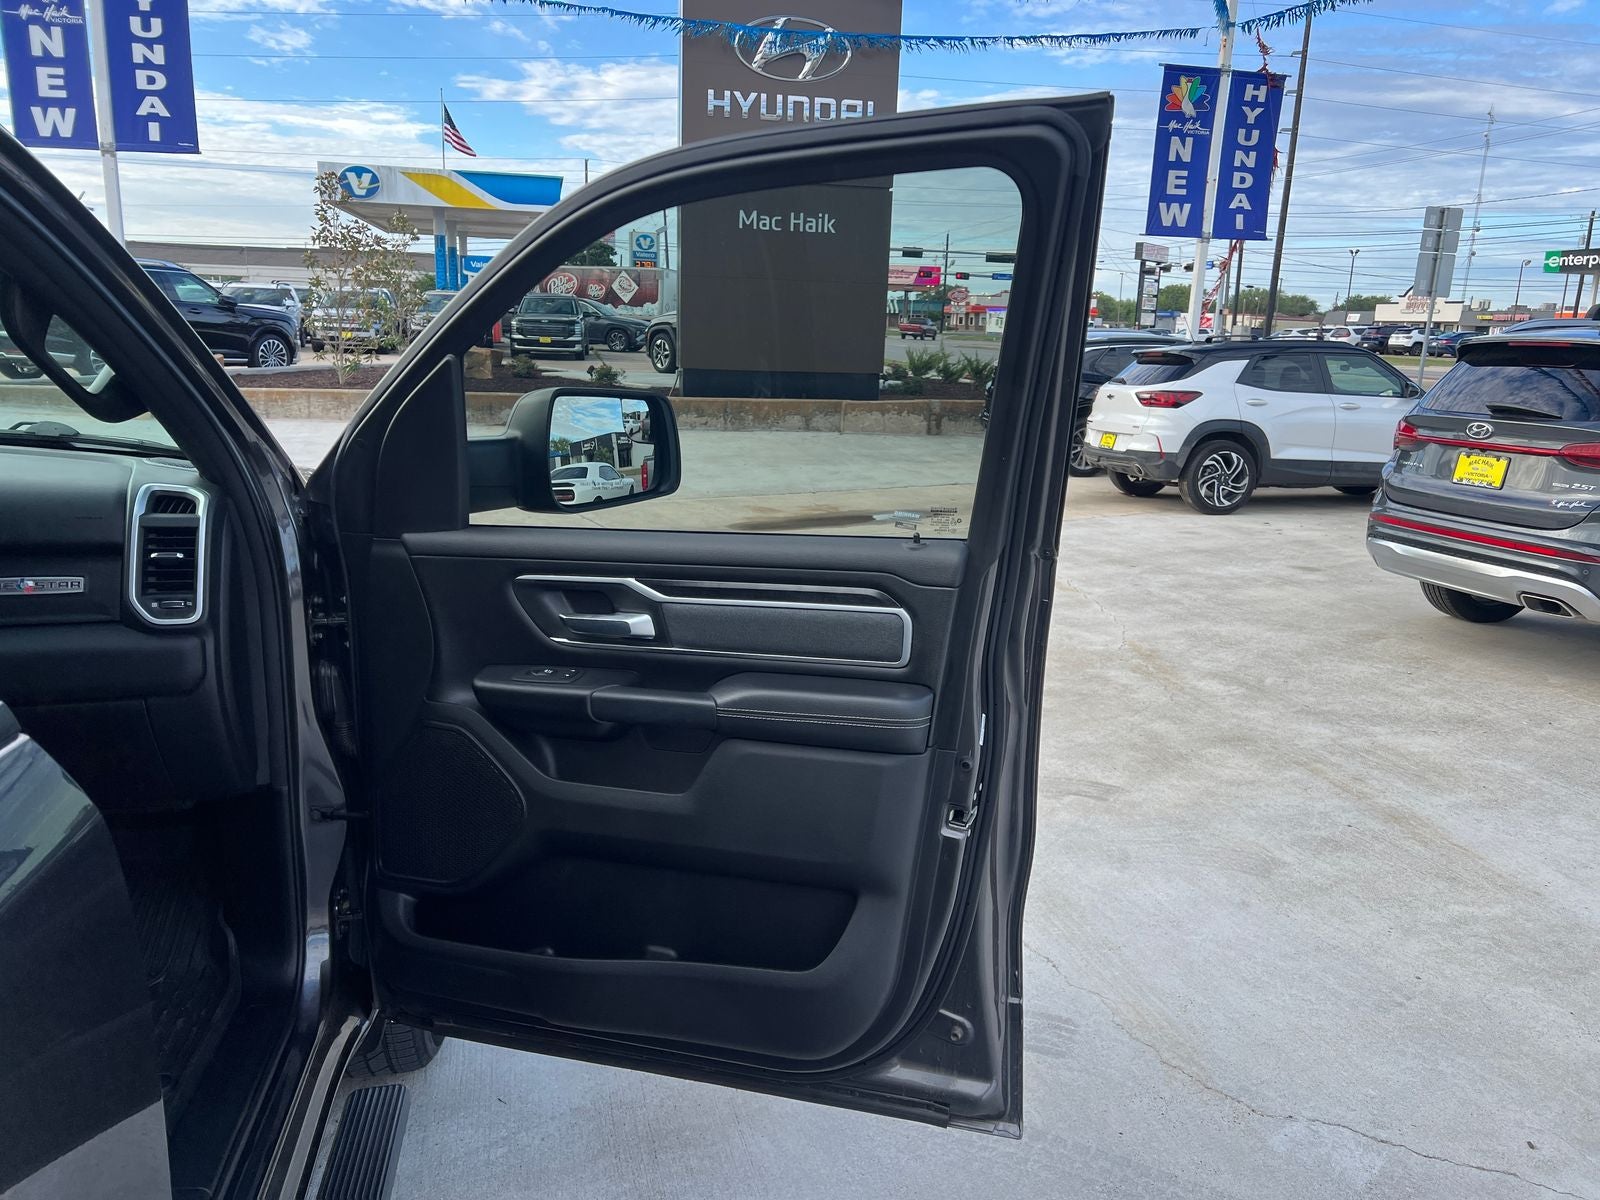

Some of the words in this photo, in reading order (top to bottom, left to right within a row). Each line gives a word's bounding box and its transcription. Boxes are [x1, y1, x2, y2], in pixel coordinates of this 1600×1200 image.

[29, 24, 76, 138] NEW
[707, 89, 874, 123] HYUNDAI
[1229, 84, 1268, 230] HYUNDAI
[1158, 136, 1194, 228] NEW
[738, 209, 782, 231] Mac
[790, 212, 836, 234] Haik
[1547, 254, 1600, 268] enterp
[558, 275, 569, 284] Dr
[35, 581, 81, 589] STAR
